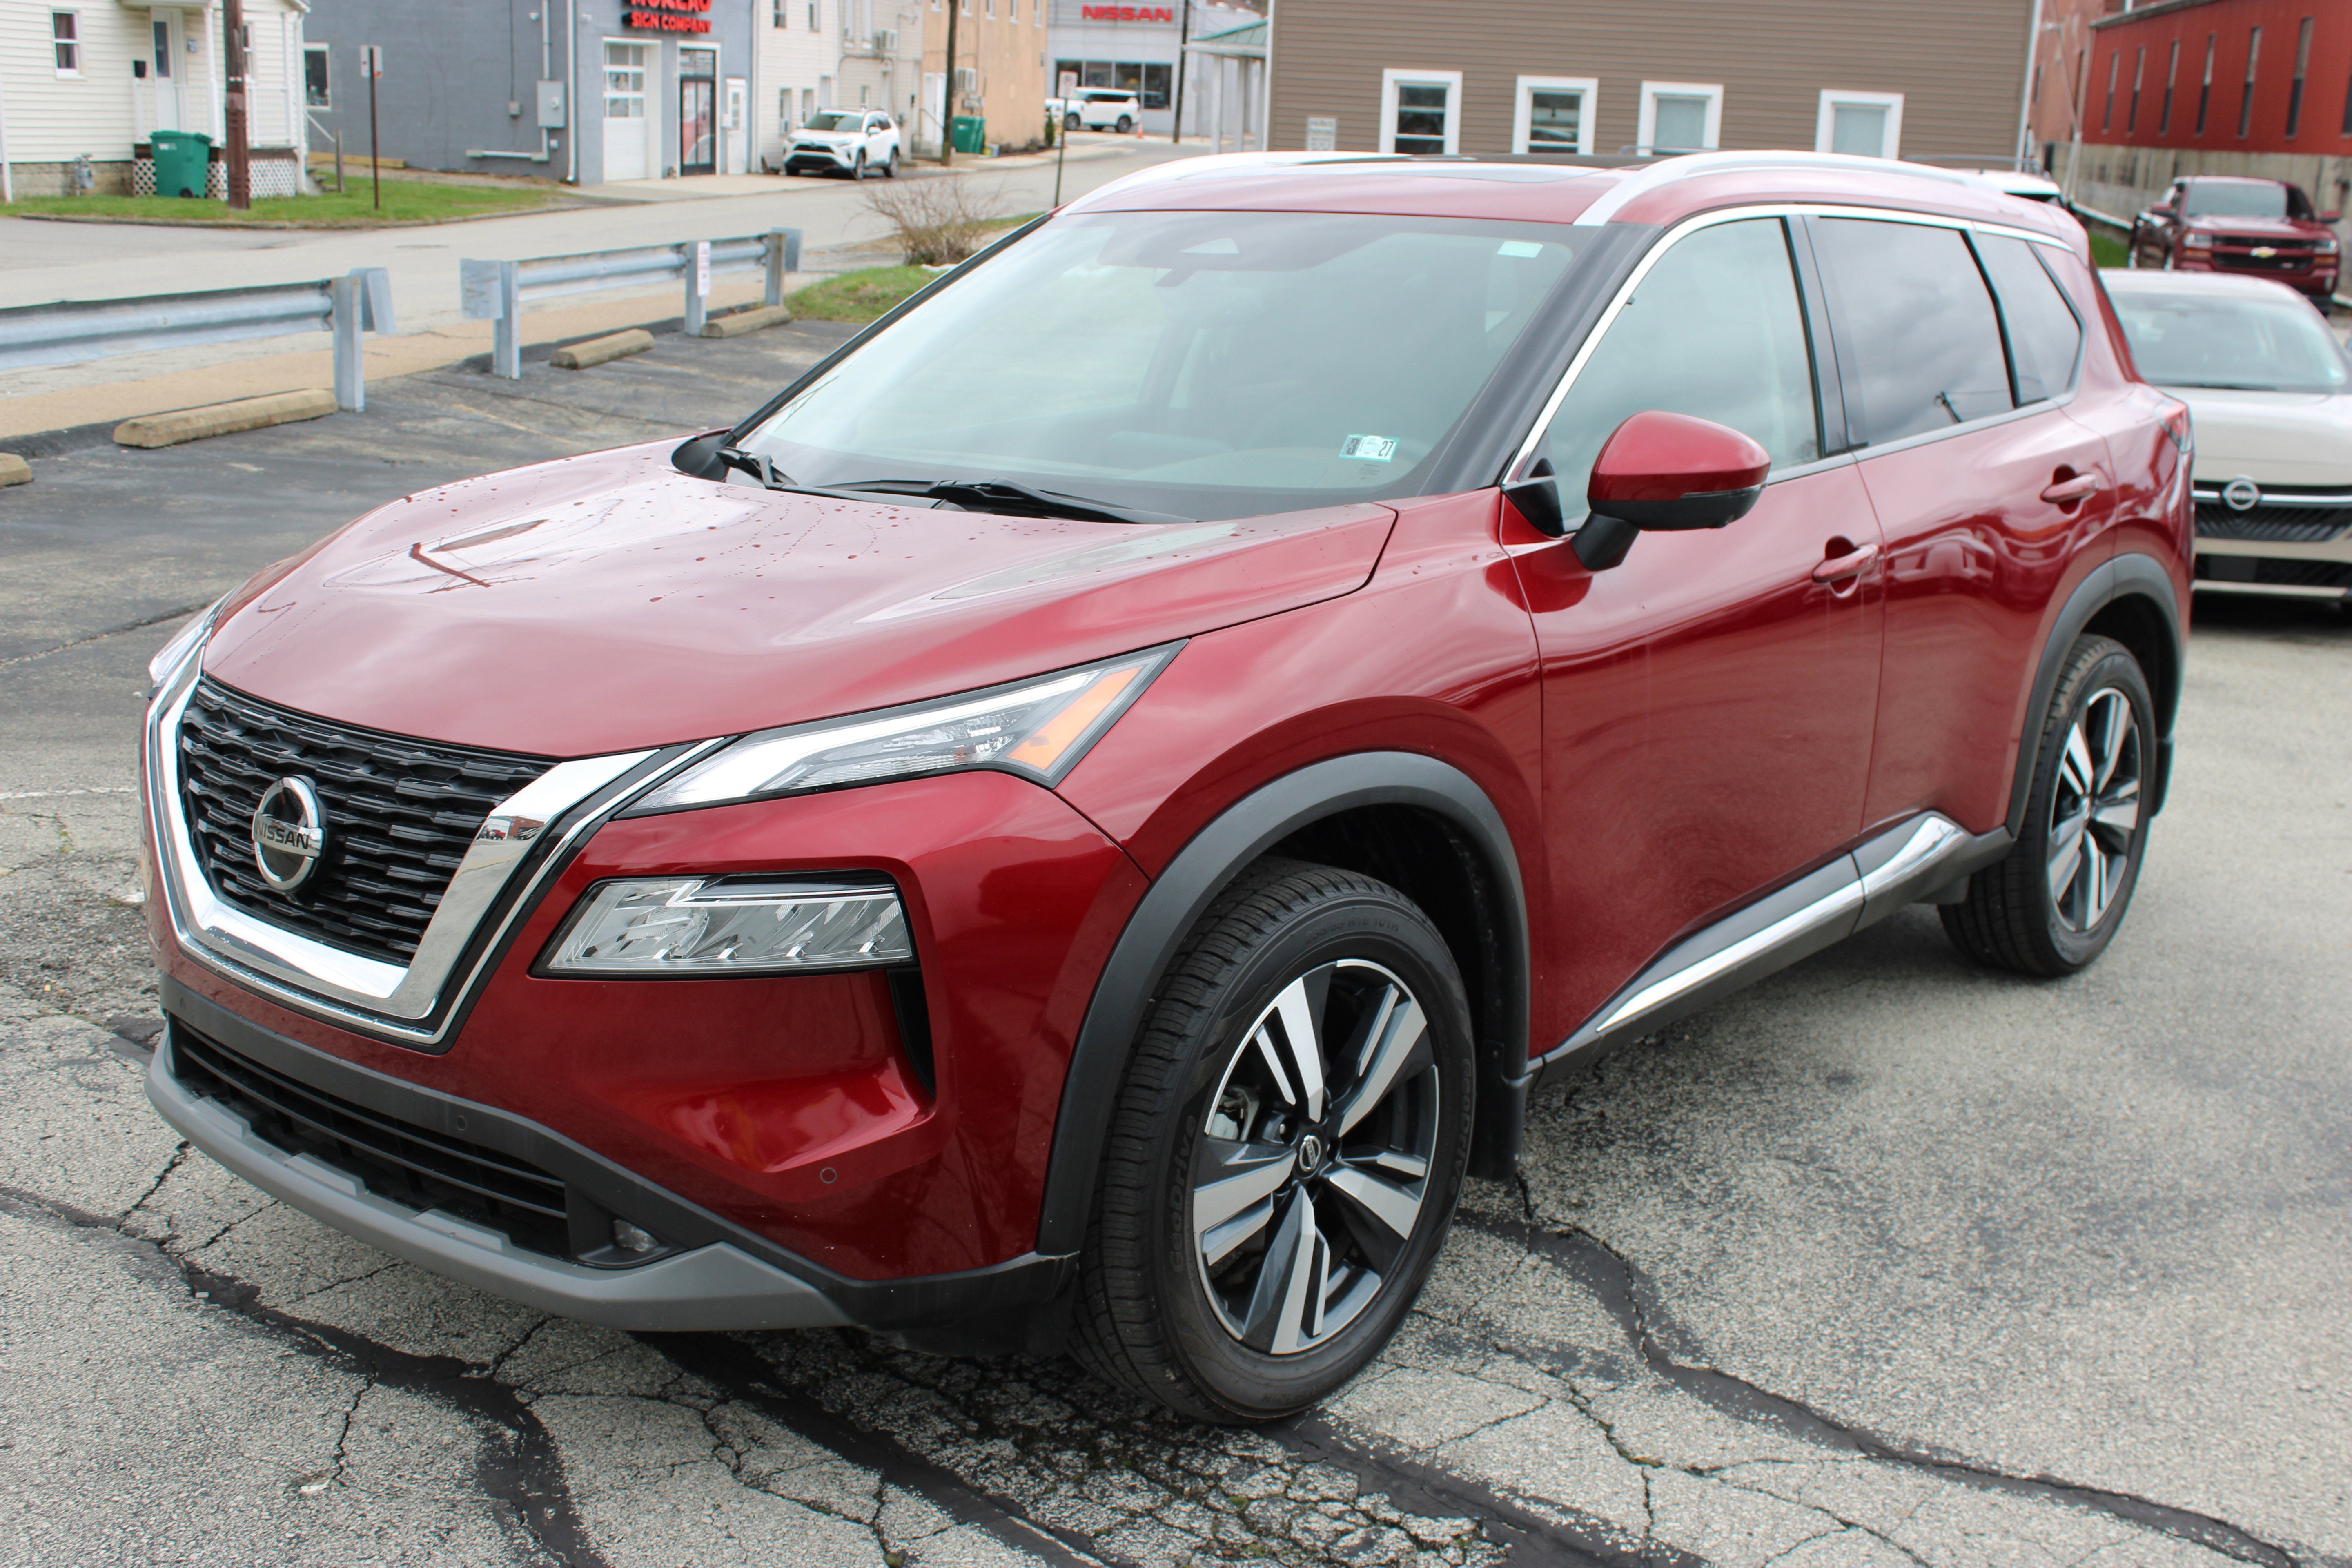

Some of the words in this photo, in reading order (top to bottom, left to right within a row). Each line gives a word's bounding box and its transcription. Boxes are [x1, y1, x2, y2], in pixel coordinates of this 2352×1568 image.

[631, 11, 659, 28] SIGN
[661, 14, 711, 33] COMPANY
[1082, 5, 1172, 22] NISSAN
[1378, 440, 1395, 457] 27
[256, 820, 310, 849] NISSAN
[1170, 1115, 1196, 1273] GeoDrive
